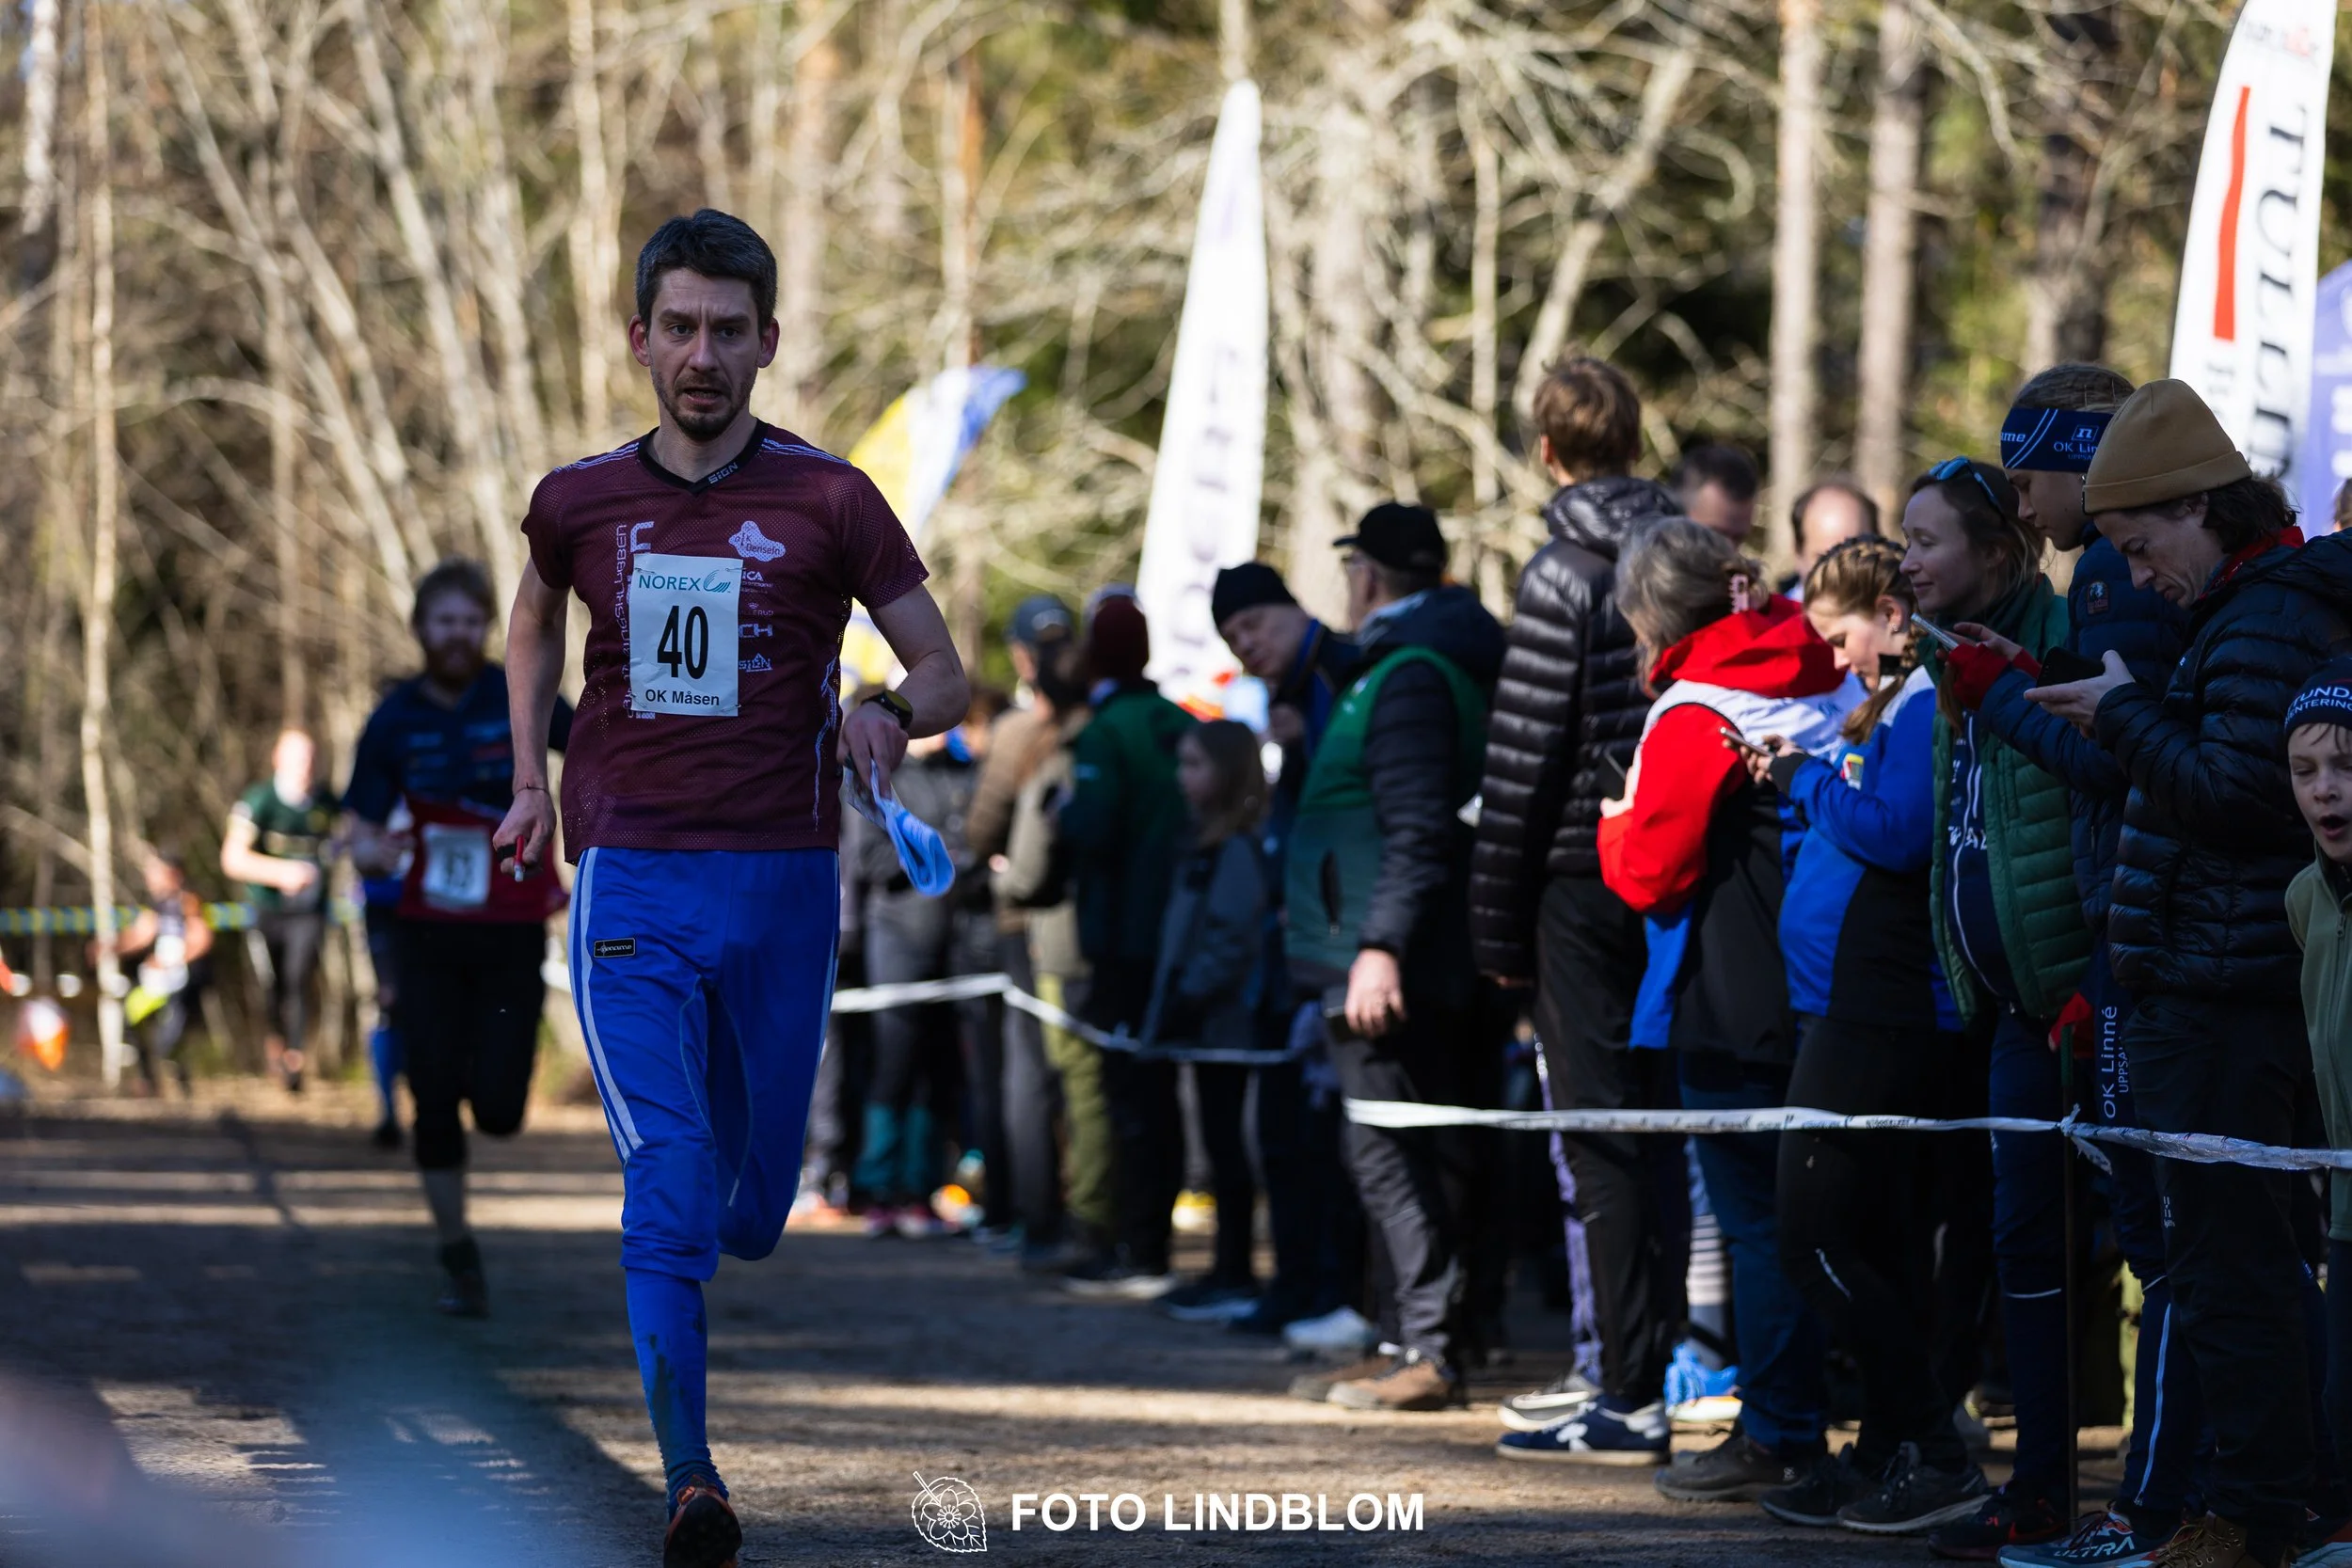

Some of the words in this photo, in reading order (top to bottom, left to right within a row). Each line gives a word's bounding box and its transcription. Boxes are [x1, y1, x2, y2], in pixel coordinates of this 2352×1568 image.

[2053, 442, 2074, 452] OK
[2079, 443, 2098, 453] Lin
[639, 575, 701, 592] NOREX
[658, 605, 708, 679] 40
[645, 689, 667, 704] OK
[672, 690, 720, 706] Måsen
[2101, 1006, 2117, 1072] Linné
[2102, 1083, 2116, 1118] OK
